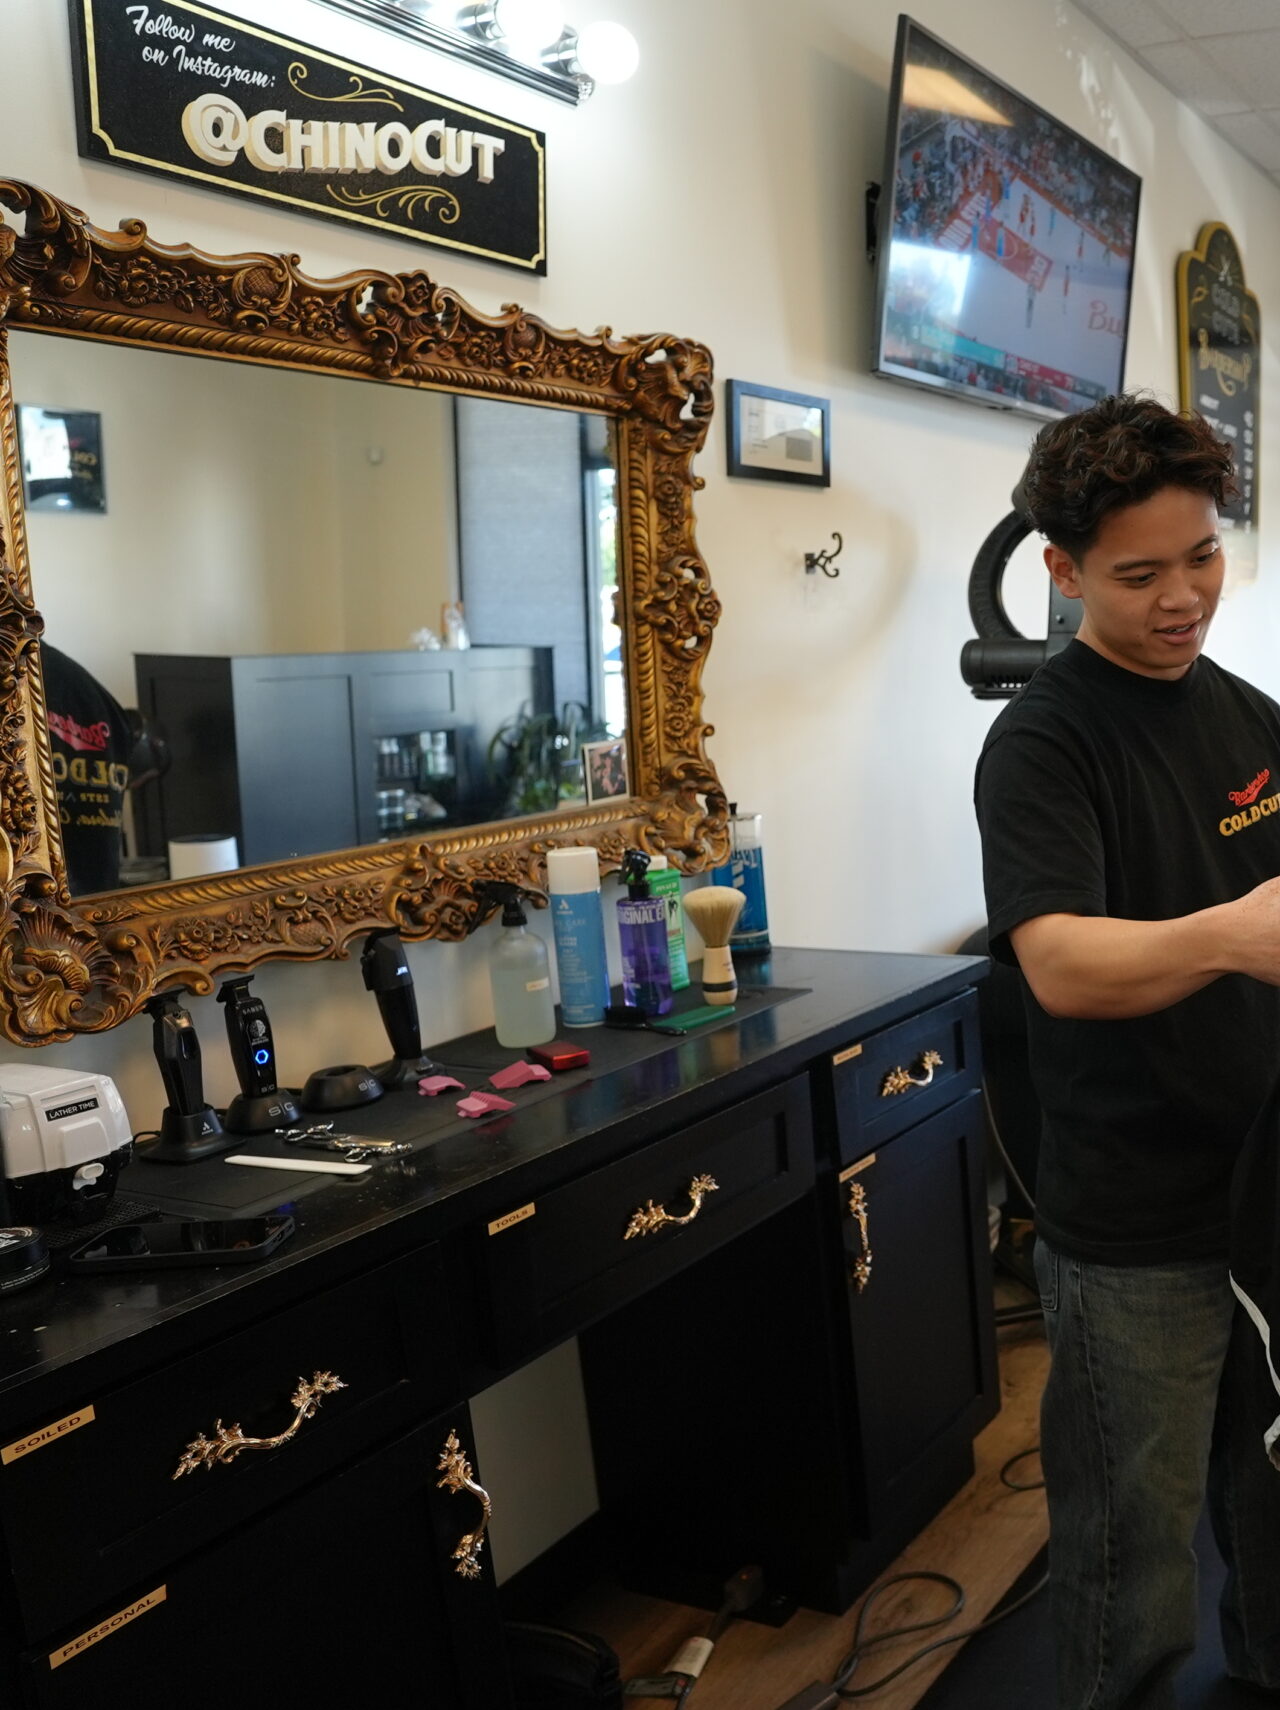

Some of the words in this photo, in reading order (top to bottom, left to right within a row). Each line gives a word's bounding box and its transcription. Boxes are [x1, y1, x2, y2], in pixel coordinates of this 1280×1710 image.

[125, 5, 195, 43] Follow
[202, 33, 236, 52] me
[141, 45, 169, 66] on
[172, 44, 276, 88] Instagram:
[48, 1105, 78, 1119] LATHER
[78, 1100, 96, 1111] TIME
[495, 1209, 528, 1229] TOOLS
[14, 1416, 81, 1454] SOILED
[62, 1598, 156, 1657] PERSONAL
